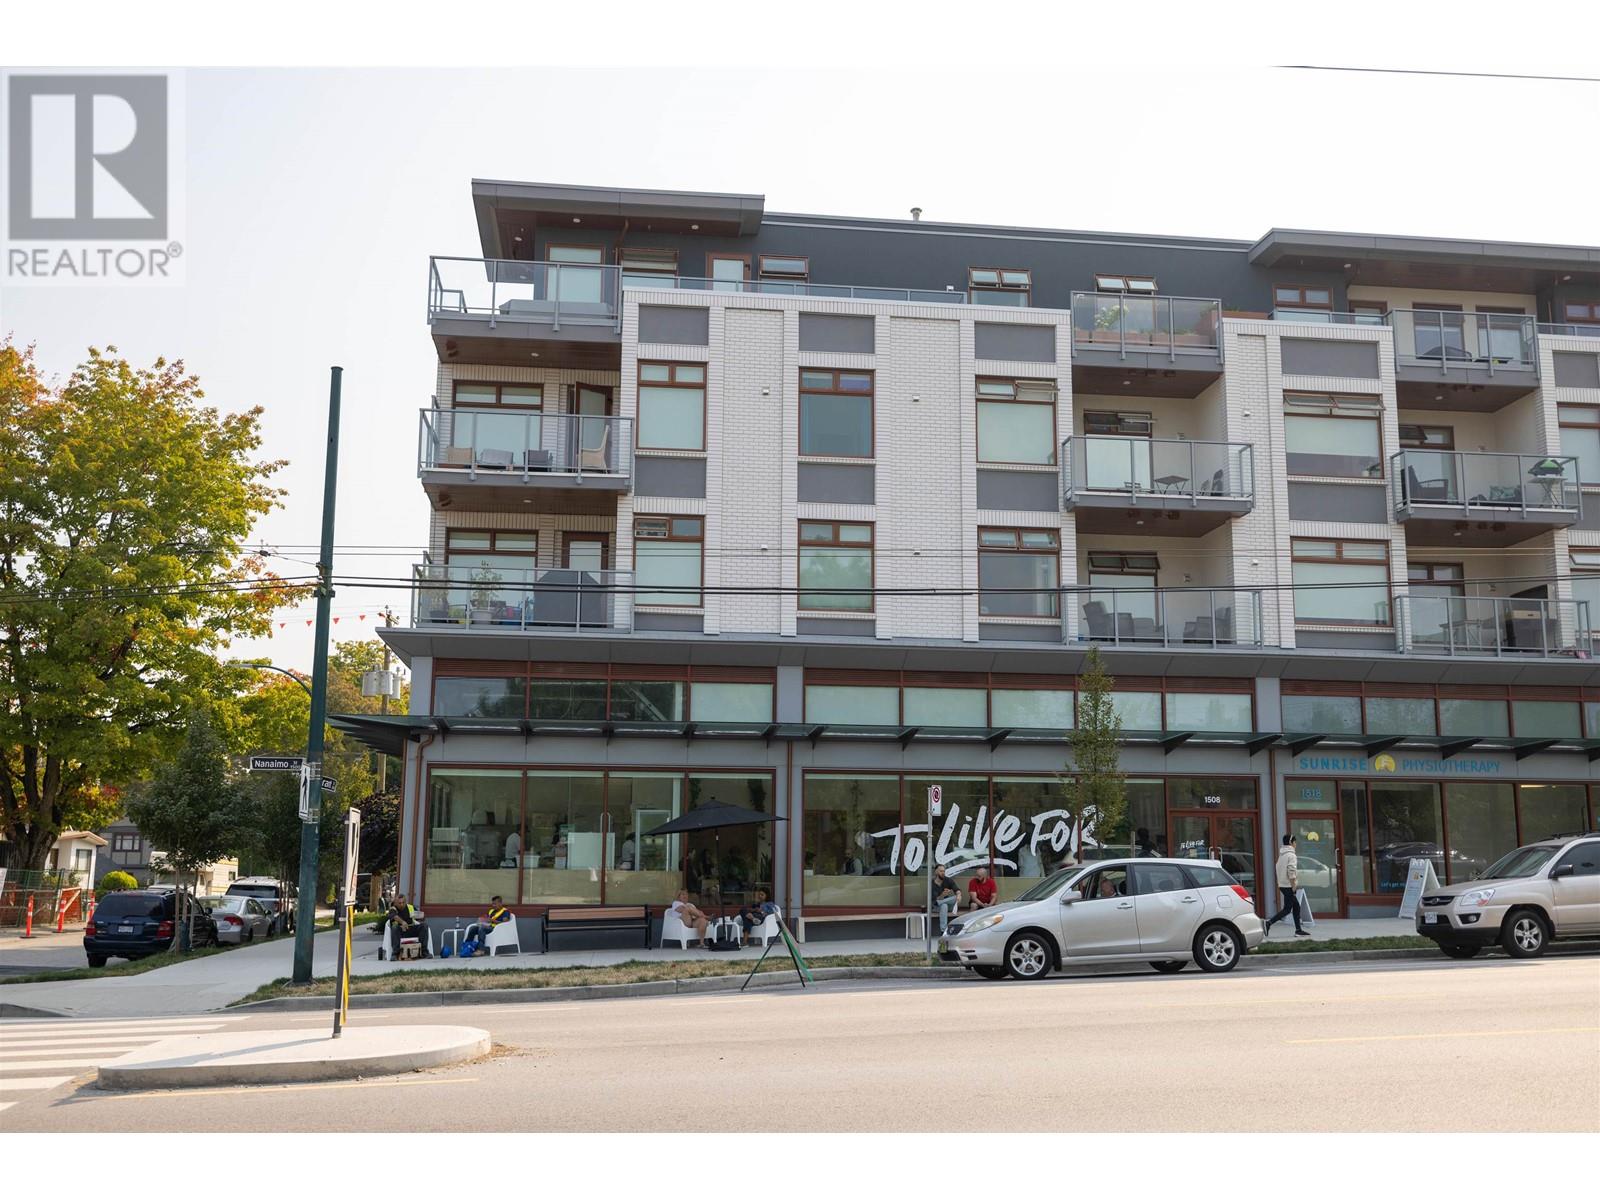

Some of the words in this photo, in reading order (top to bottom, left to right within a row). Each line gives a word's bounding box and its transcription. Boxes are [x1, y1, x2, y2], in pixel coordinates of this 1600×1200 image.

[254, 759, 289, 768] Nanaimo
[1300, 757, 1367, 771] SUNRISE
[1402, 758, 1500, 774] PHYSIOTHERAPY
[1204, 796, 1221, 804] 1508
